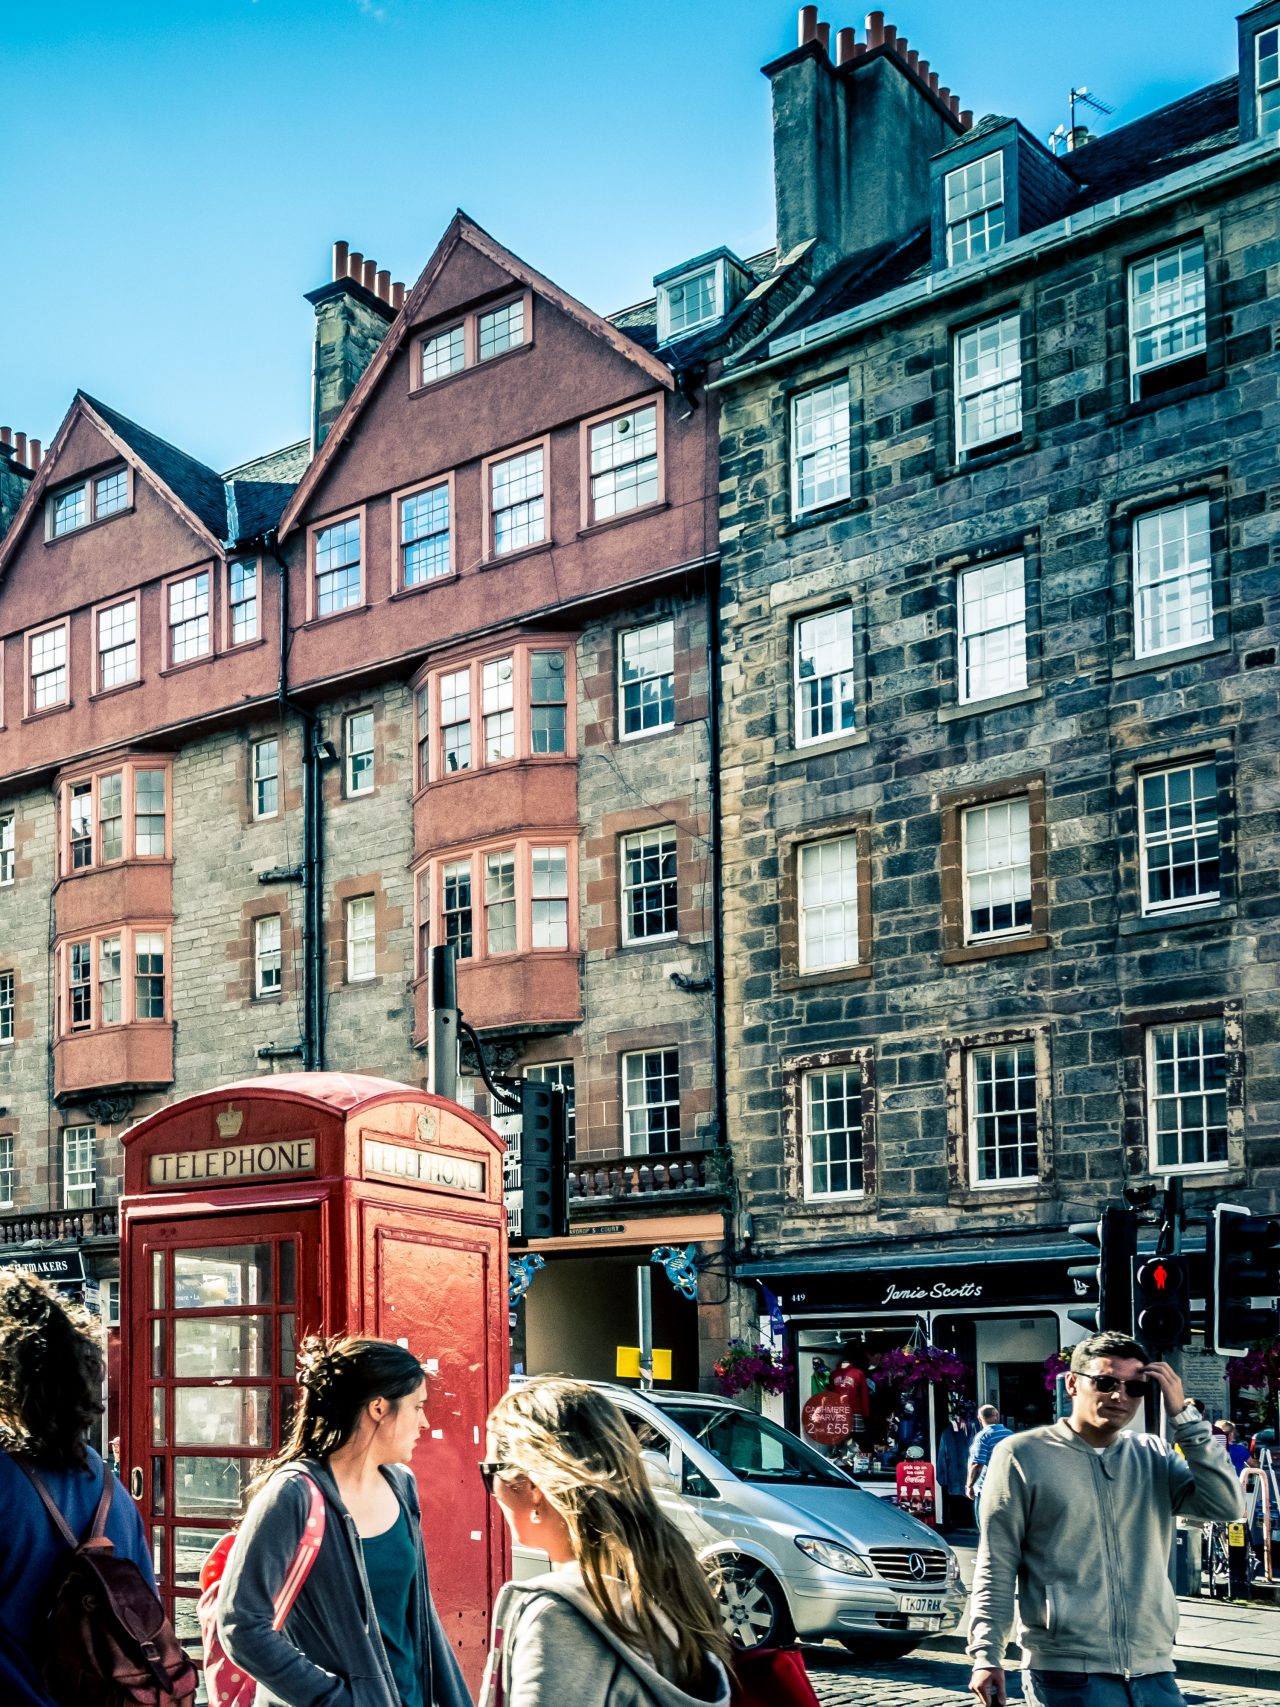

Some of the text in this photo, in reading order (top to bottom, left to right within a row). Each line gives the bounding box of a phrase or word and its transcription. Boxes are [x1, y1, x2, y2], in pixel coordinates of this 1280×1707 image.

[158, 1142, 311, 1181] TELEPHONE
[365, 1144, 478, 1190] TELEPHONE
[791, 1294, 806, 1302] 449
[881, 1284, 928, 1305] Jamie
[805, 1406, 851, 1414] CASHMERE
[807, 1422, 815, 1434] 2
[826, 1422, 849, 1435] £55
[905, 1598, 927, 1611] TK07
